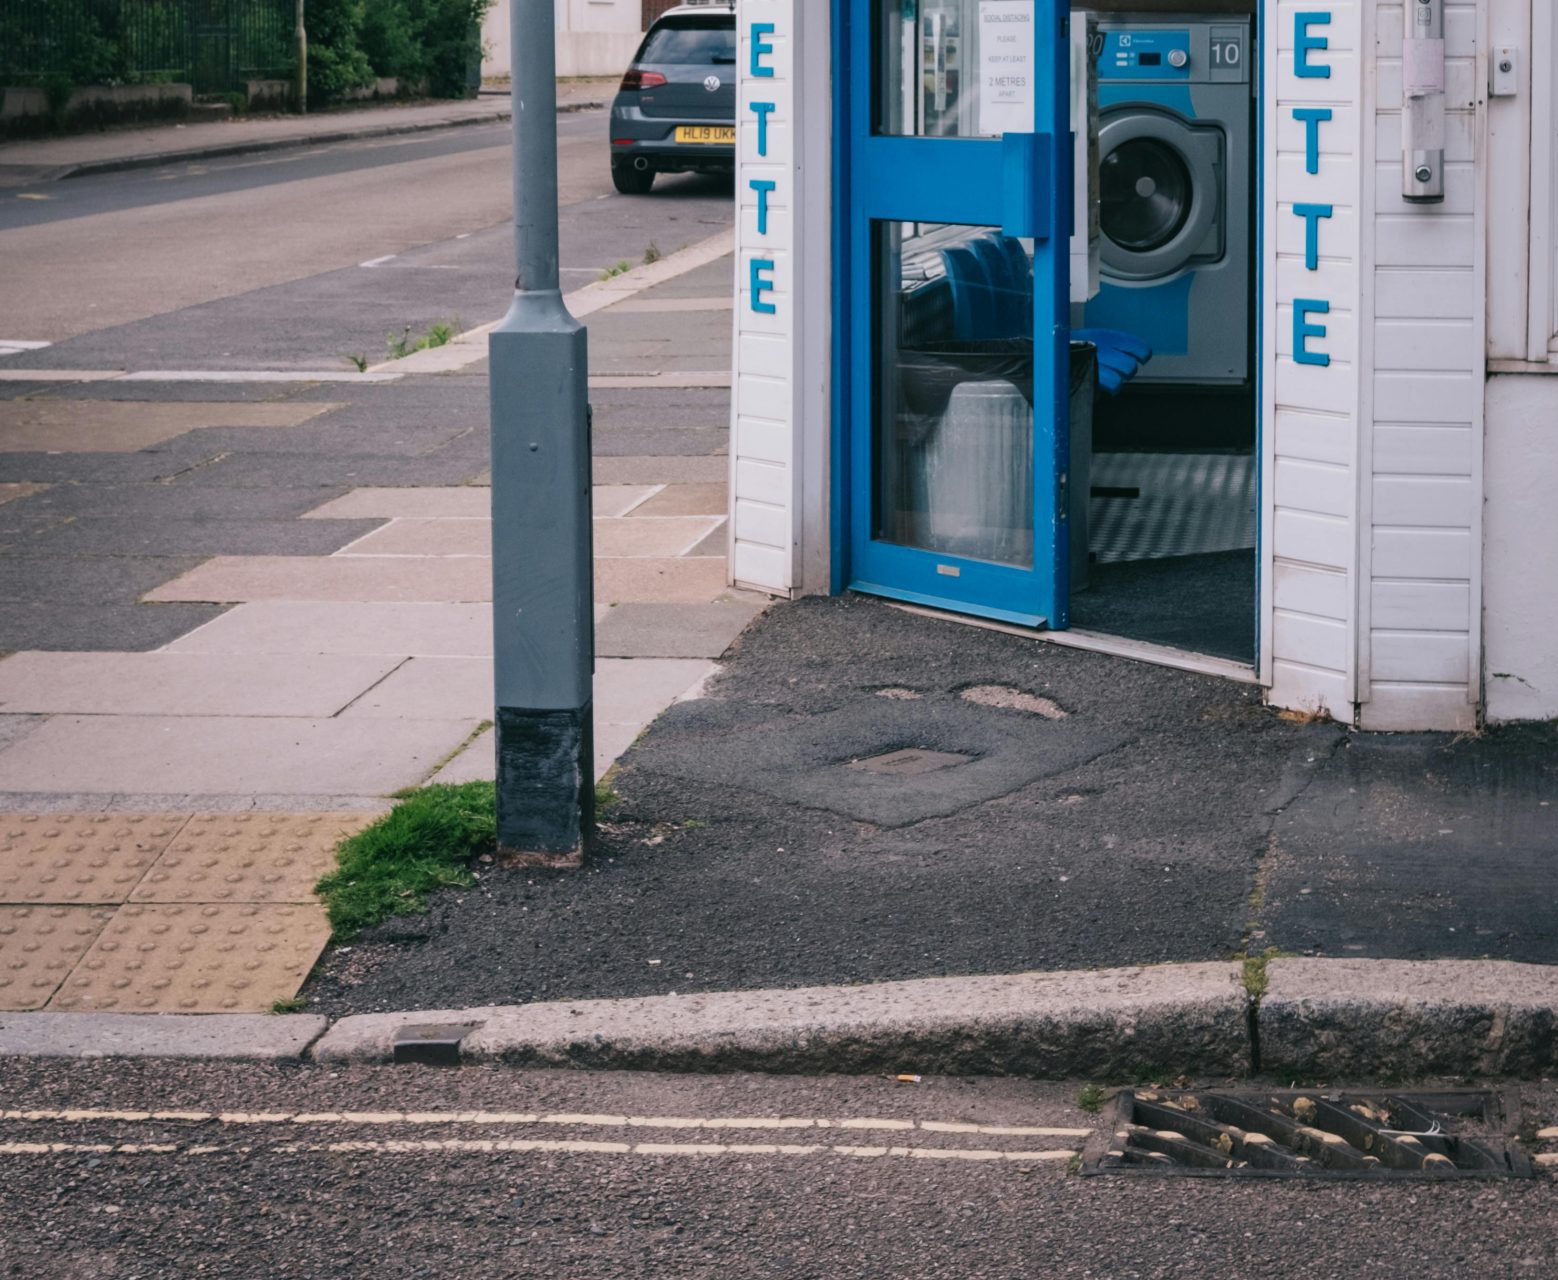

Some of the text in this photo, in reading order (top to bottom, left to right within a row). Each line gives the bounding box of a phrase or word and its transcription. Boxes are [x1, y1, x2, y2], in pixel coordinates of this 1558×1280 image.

[997, 35, 1017, 43] PLEASE
[1211, 43, 1240, 65] 10
[989, 76, 1026, 87] 2 METRES
[683, 128, 710, 140] HL19
